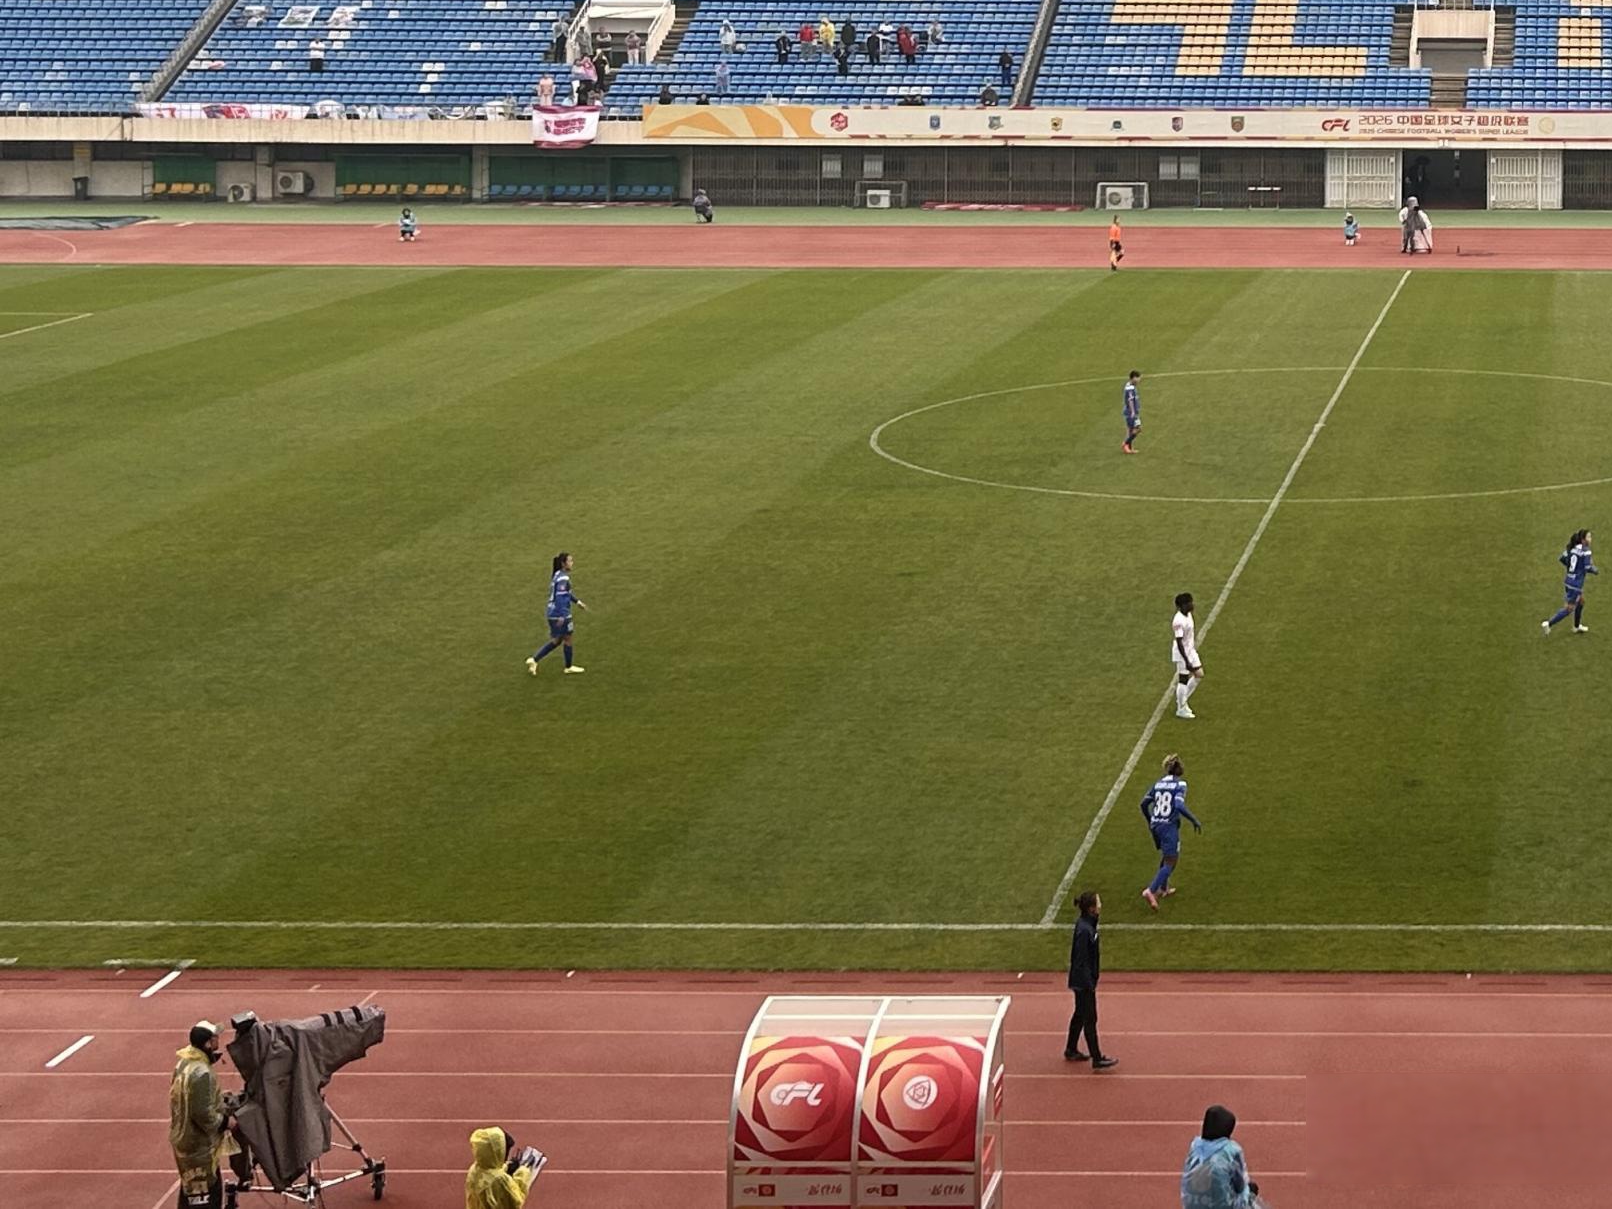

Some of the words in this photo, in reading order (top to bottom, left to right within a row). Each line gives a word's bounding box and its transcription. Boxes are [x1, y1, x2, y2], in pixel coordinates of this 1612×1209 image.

[1358, 115, 1393, 126] 2026
[1569, 555, 1578, 572] 9
[1153, 791, 1172, 816] 38
